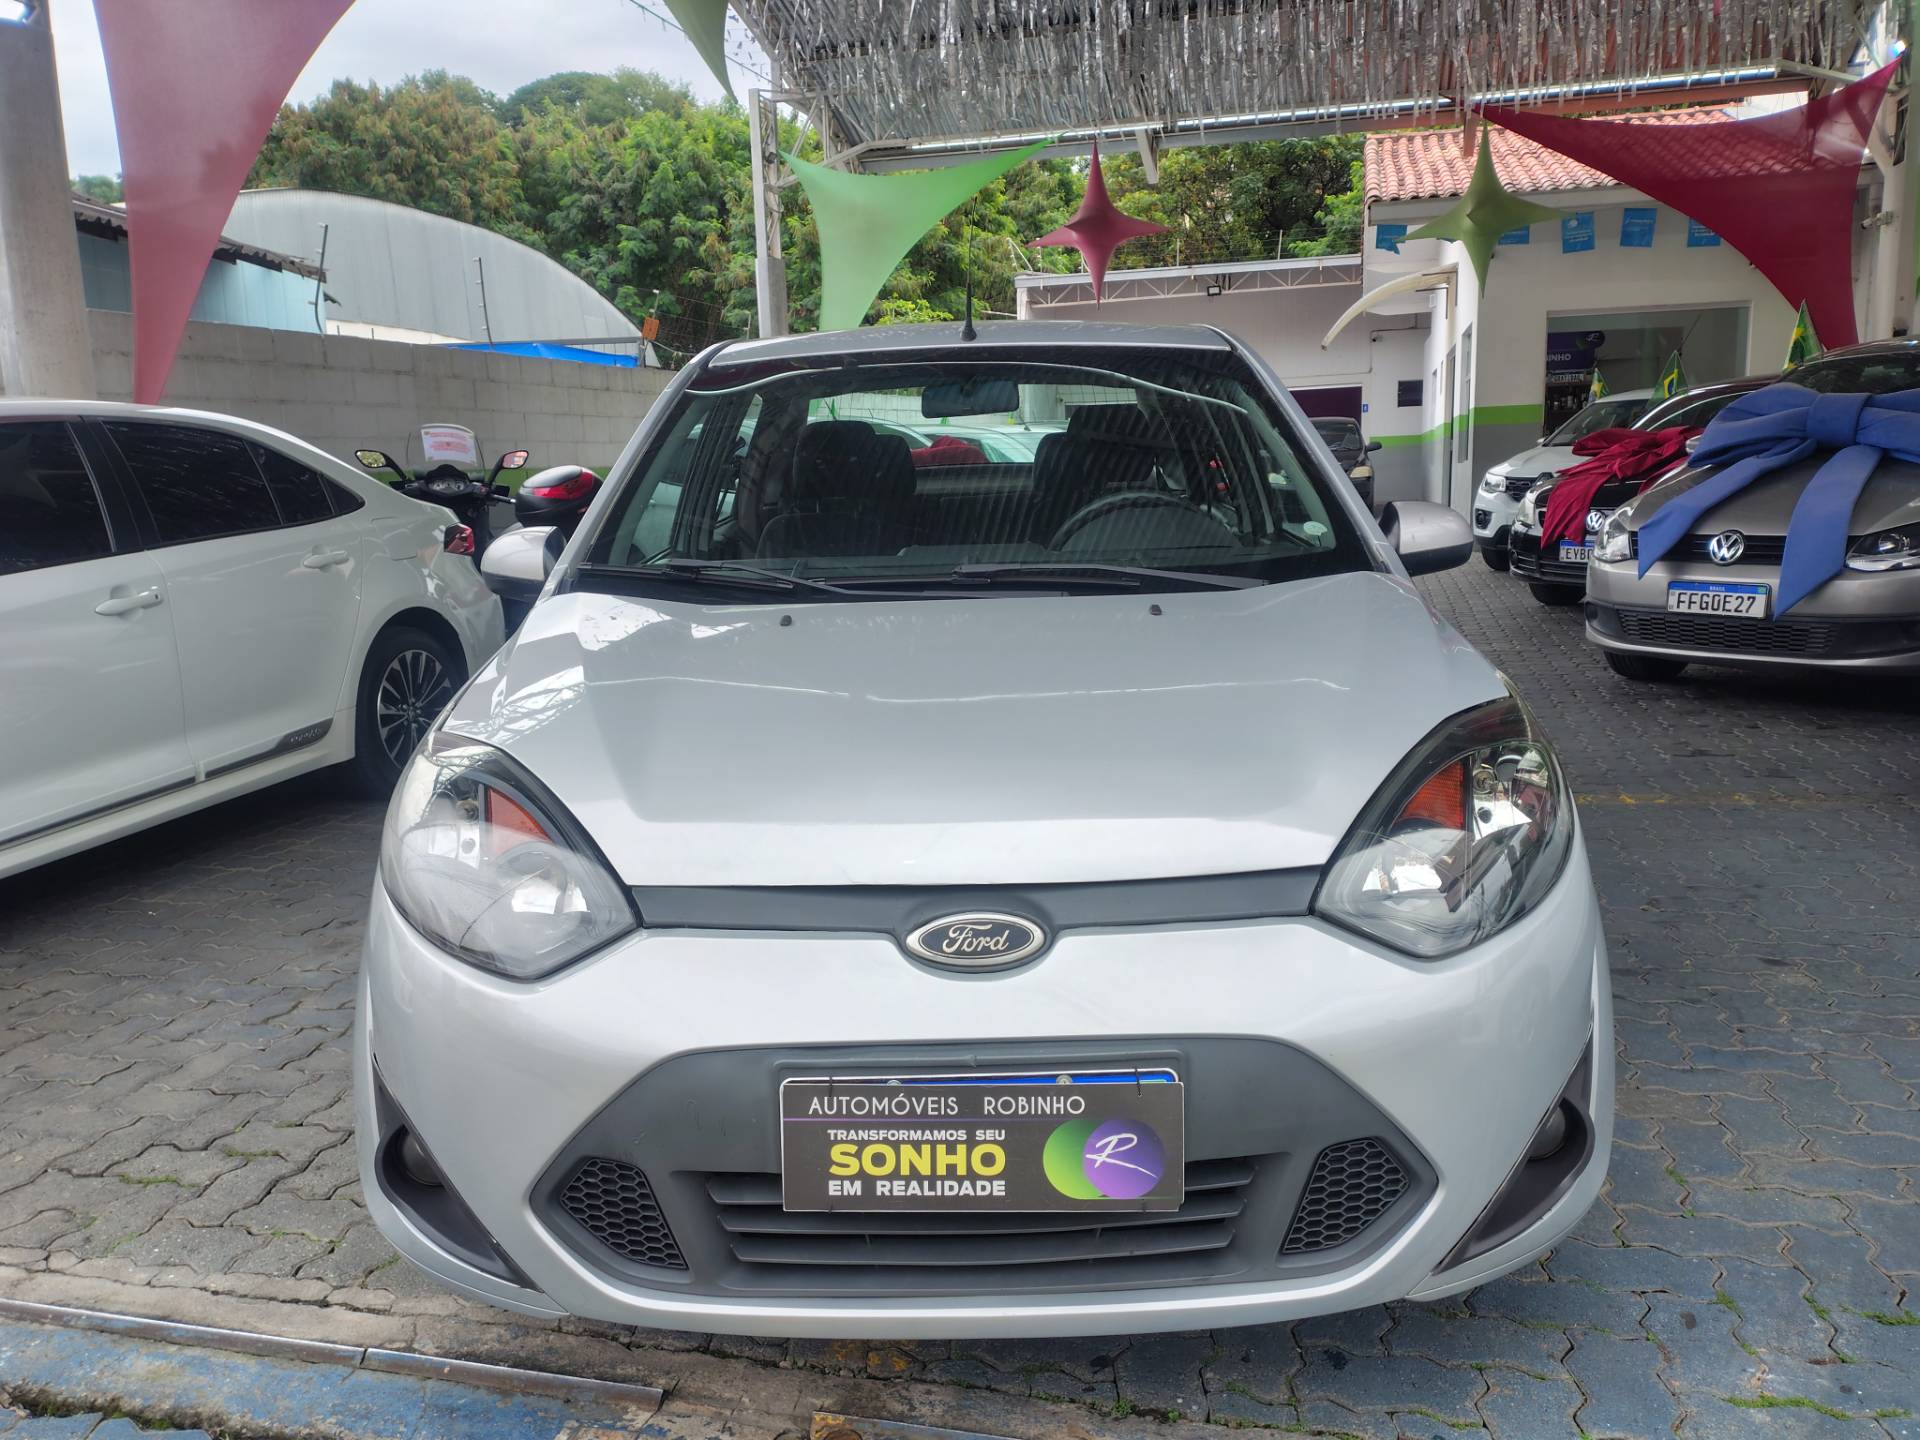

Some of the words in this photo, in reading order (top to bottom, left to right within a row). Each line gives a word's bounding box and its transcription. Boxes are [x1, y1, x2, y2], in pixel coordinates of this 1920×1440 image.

[1546, 353, 1572, 361] INHO
[942, 924, 1010, 953] Ford
[808, 1093, 959, 1115] AUTOMÓVEIS
[983, 1096, 1086, 1115] ROBINHO
[827, 1129, 967, 1141] TRANSFORMAMOS
[975, 1129, 1006, 1141] SEU
[829, 1143, 1006, 1177] SONHO
[828, 1180, 862, 1196] EM
[876, 1180, 1006, 1196] REALIDADE
